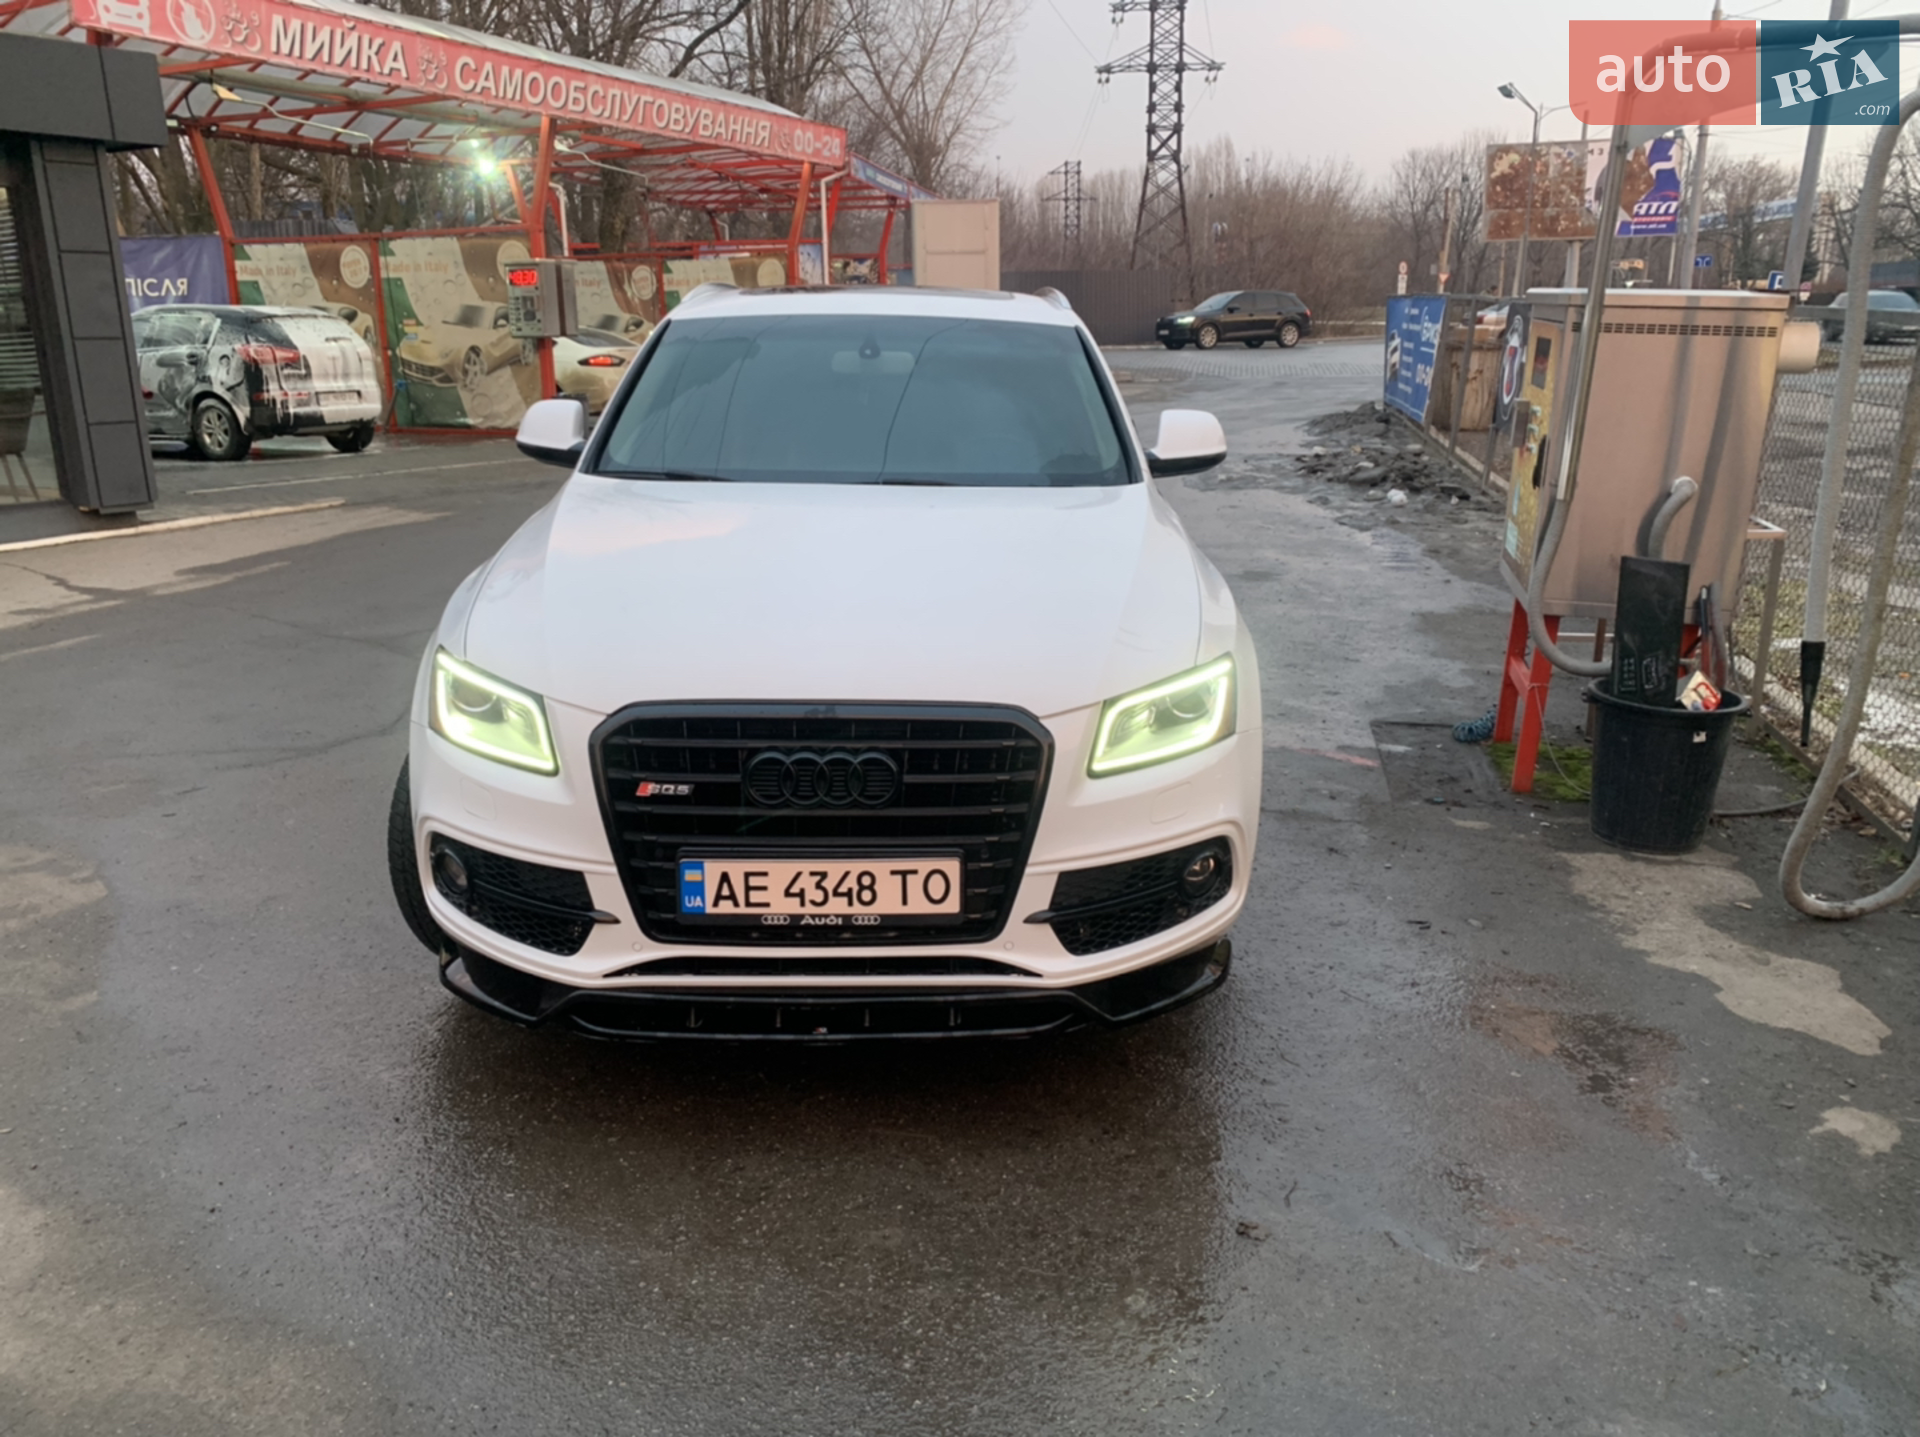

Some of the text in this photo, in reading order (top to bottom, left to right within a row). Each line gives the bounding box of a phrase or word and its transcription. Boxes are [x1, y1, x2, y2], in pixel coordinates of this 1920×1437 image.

[269, 14, 841, 158] МИЙКА САМООБСЛУГОВУВАННЯ 00-24
[712, 869, 952, 908] AE 4348 TO
[684, 896, 704, 908] UA
[800, 914, 843, 925] Audi
